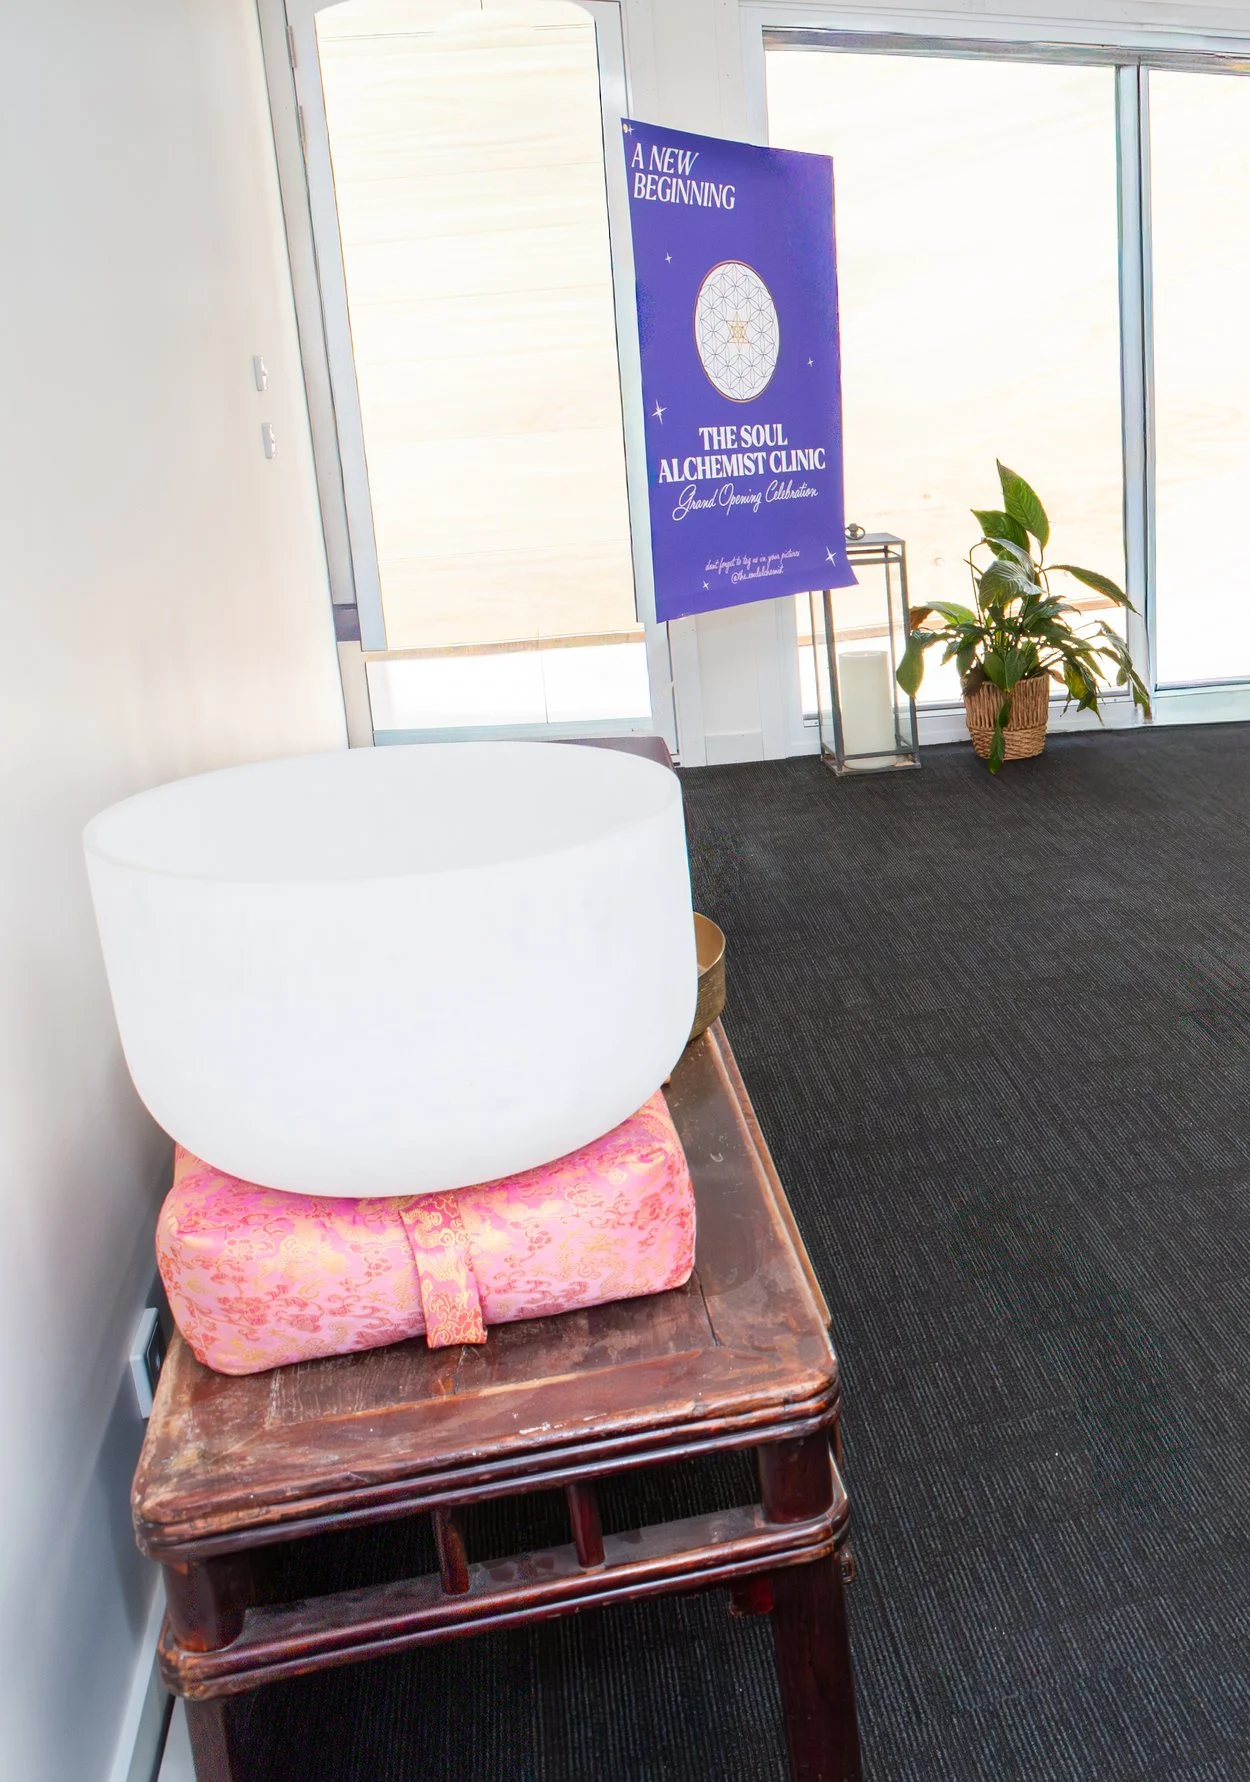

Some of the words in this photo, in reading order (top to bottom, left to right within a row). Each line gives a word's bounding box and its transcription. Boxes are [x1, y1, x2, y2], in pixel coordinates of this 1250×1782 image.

[631, 142, 644, 169] A
[649, 145, 699, 176] NEW
[633, 172, 735, 210] BEGINNING
[699, 426, 738, 450] THE
[740, 423, 788, 448] SOUL
[658, 452, 767, 483] ALCHEMIST
[769, 448, 826, 473] CLINIC
[672, 484, 716, 521] Grand
[718, 482, 762, 516] Opening
[765, 479, 819, 503] Celebration
